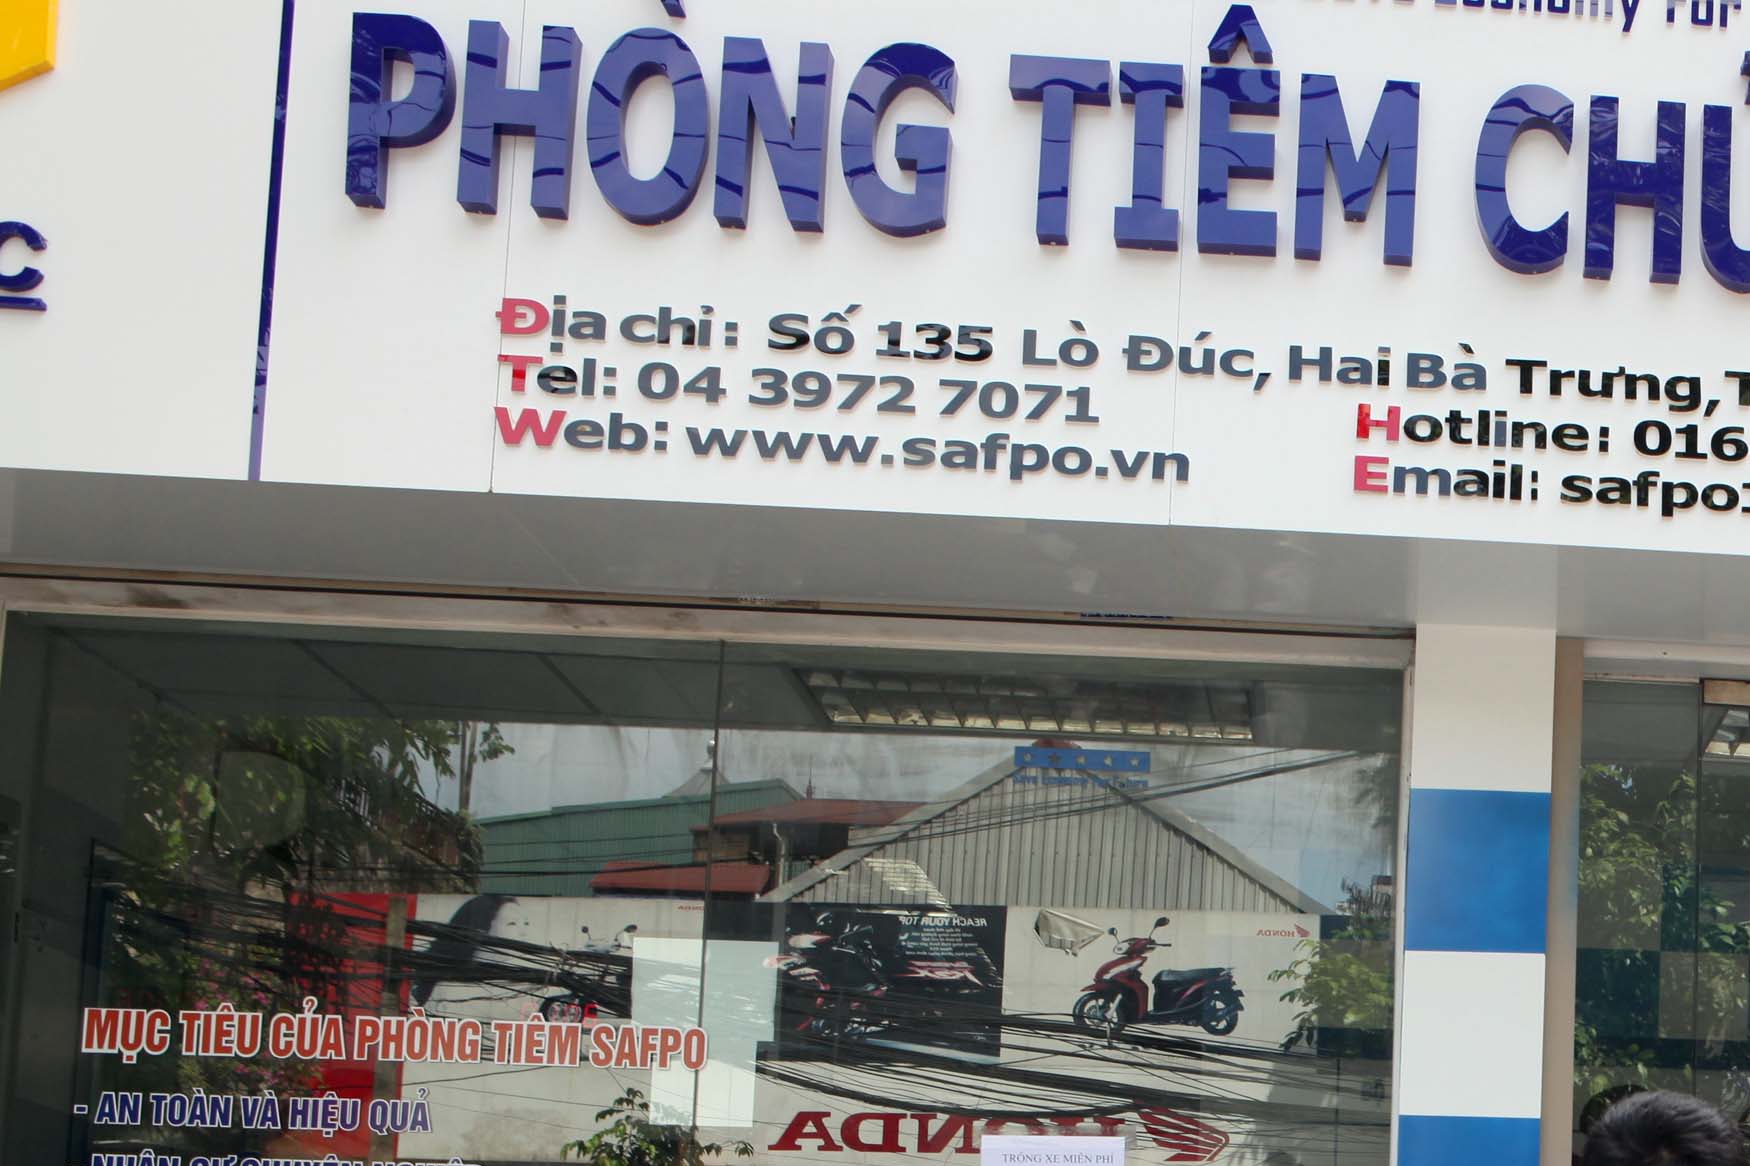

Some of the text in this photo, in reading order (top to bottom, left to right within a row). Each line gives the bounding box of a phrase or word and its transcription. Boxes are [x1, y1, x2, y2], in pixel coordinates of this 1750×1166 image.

[345, 0, 957, 237] PHÒNG
[1008, 3, 1421, 267] TIÊM
[496, 295, 606, 352] Địa
[620, 306, 737, 346] chỉ:
[768, 305, 860, 354] Số
[876, 322, 992, 362] 135
[1023, 321, 1098, 367] Lò
[1123, 332, 1270, 390] Đúc,
[1289, 346, 1390, 386] Hai
[1407, 343, 1486, 390] Bà
[498, 355, 1099, 422] Tel: 04 3972 7071
[495, 407, 1189, 481] Web: www.safpo.vn
[1357, 404, 1609, 452] Hotline:
[1354, 456, 1538, 500] Email:
[81, 996, 709, 1071] MỤC TIÊU CỦA PHÒNG TIÊM SAFPO
[94, 1087, 432, 1137] AN TOÀN VÀ HIỆU QUẢ
